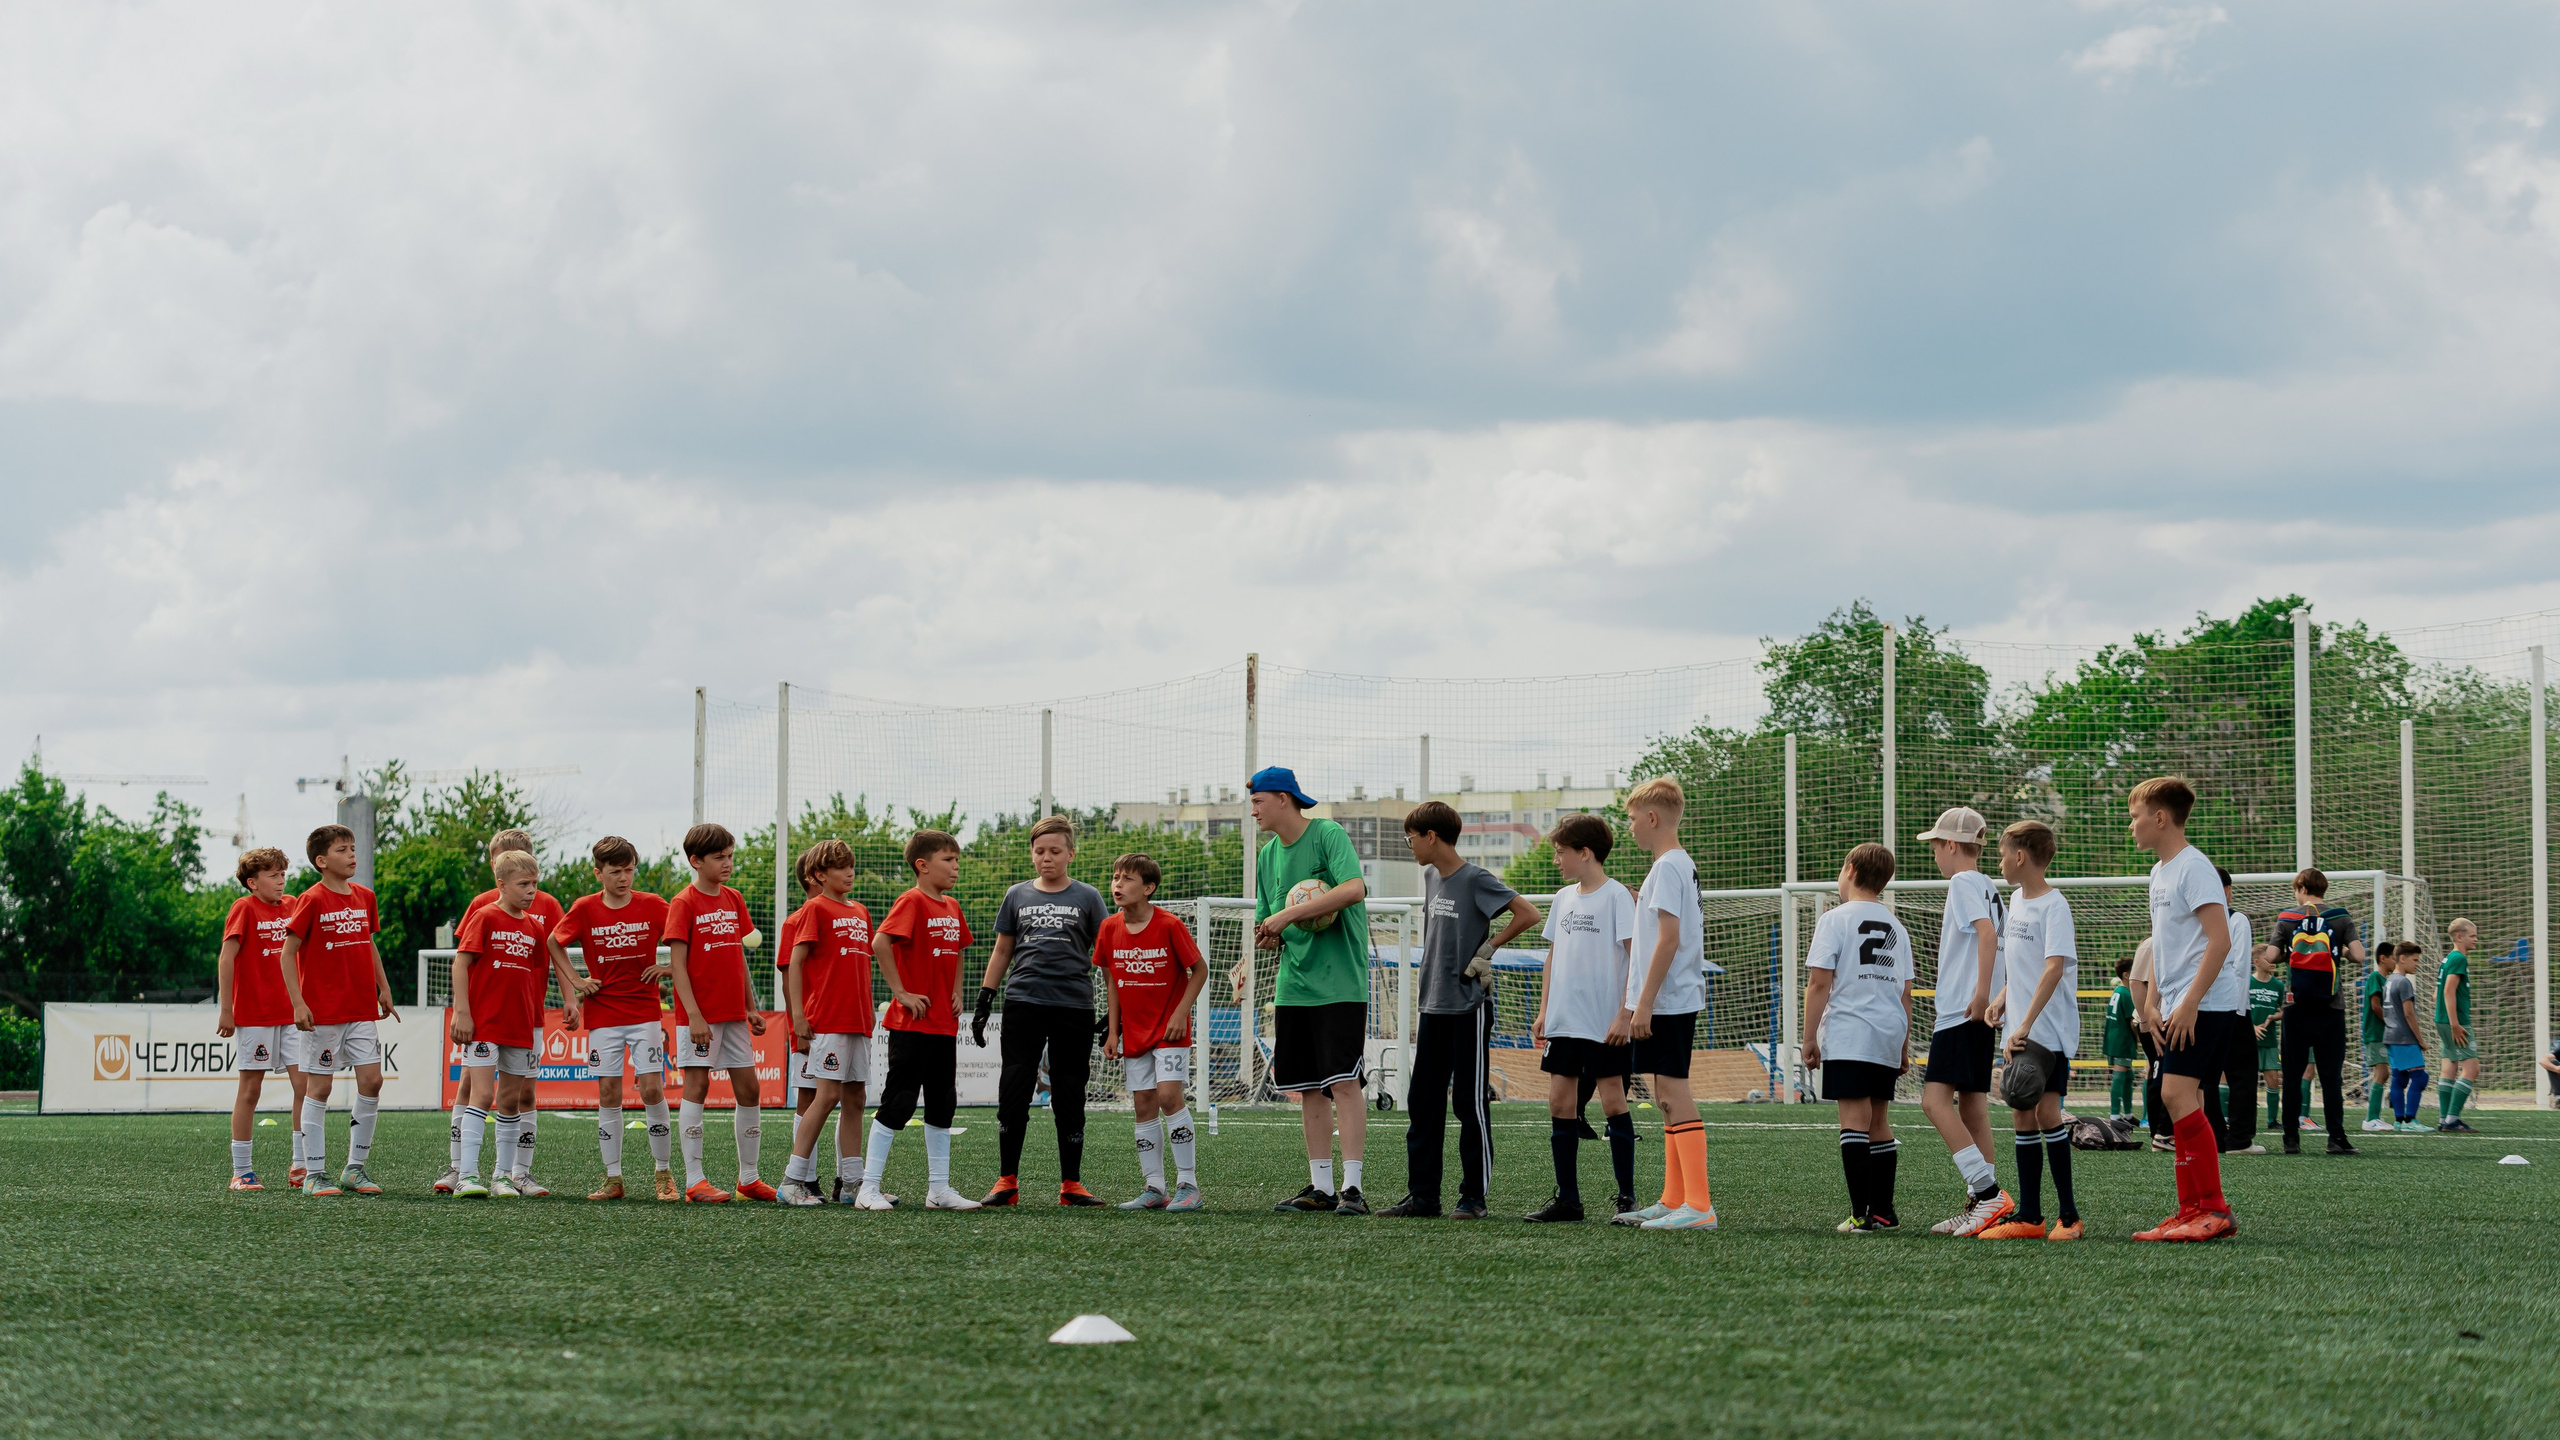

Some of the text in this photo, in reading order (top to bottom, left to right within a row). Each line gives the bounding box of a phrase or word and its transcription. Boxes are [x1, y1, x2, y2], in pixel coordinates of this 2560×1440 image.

[336, 920, 362, 934] 2026
[710, 921, 736, 935] 2026
[1031, 915, 1063, 929] 2026
[1572, 925, 1601, 934] КОМПАНИЯ
[604, 934, 638, 949] 2026
[848, 927, 869, 943] 2026
[505, 941, 529, 959] 2026
[1857, 920, 1898, 968] 2
[1124, 959, 1155, 974] 2026
[648, 1046, 663, 1064] 29
[1164, 1055, 1183, 1072] 52
[537, 1067, 570, 1080] ИЗКИХ
